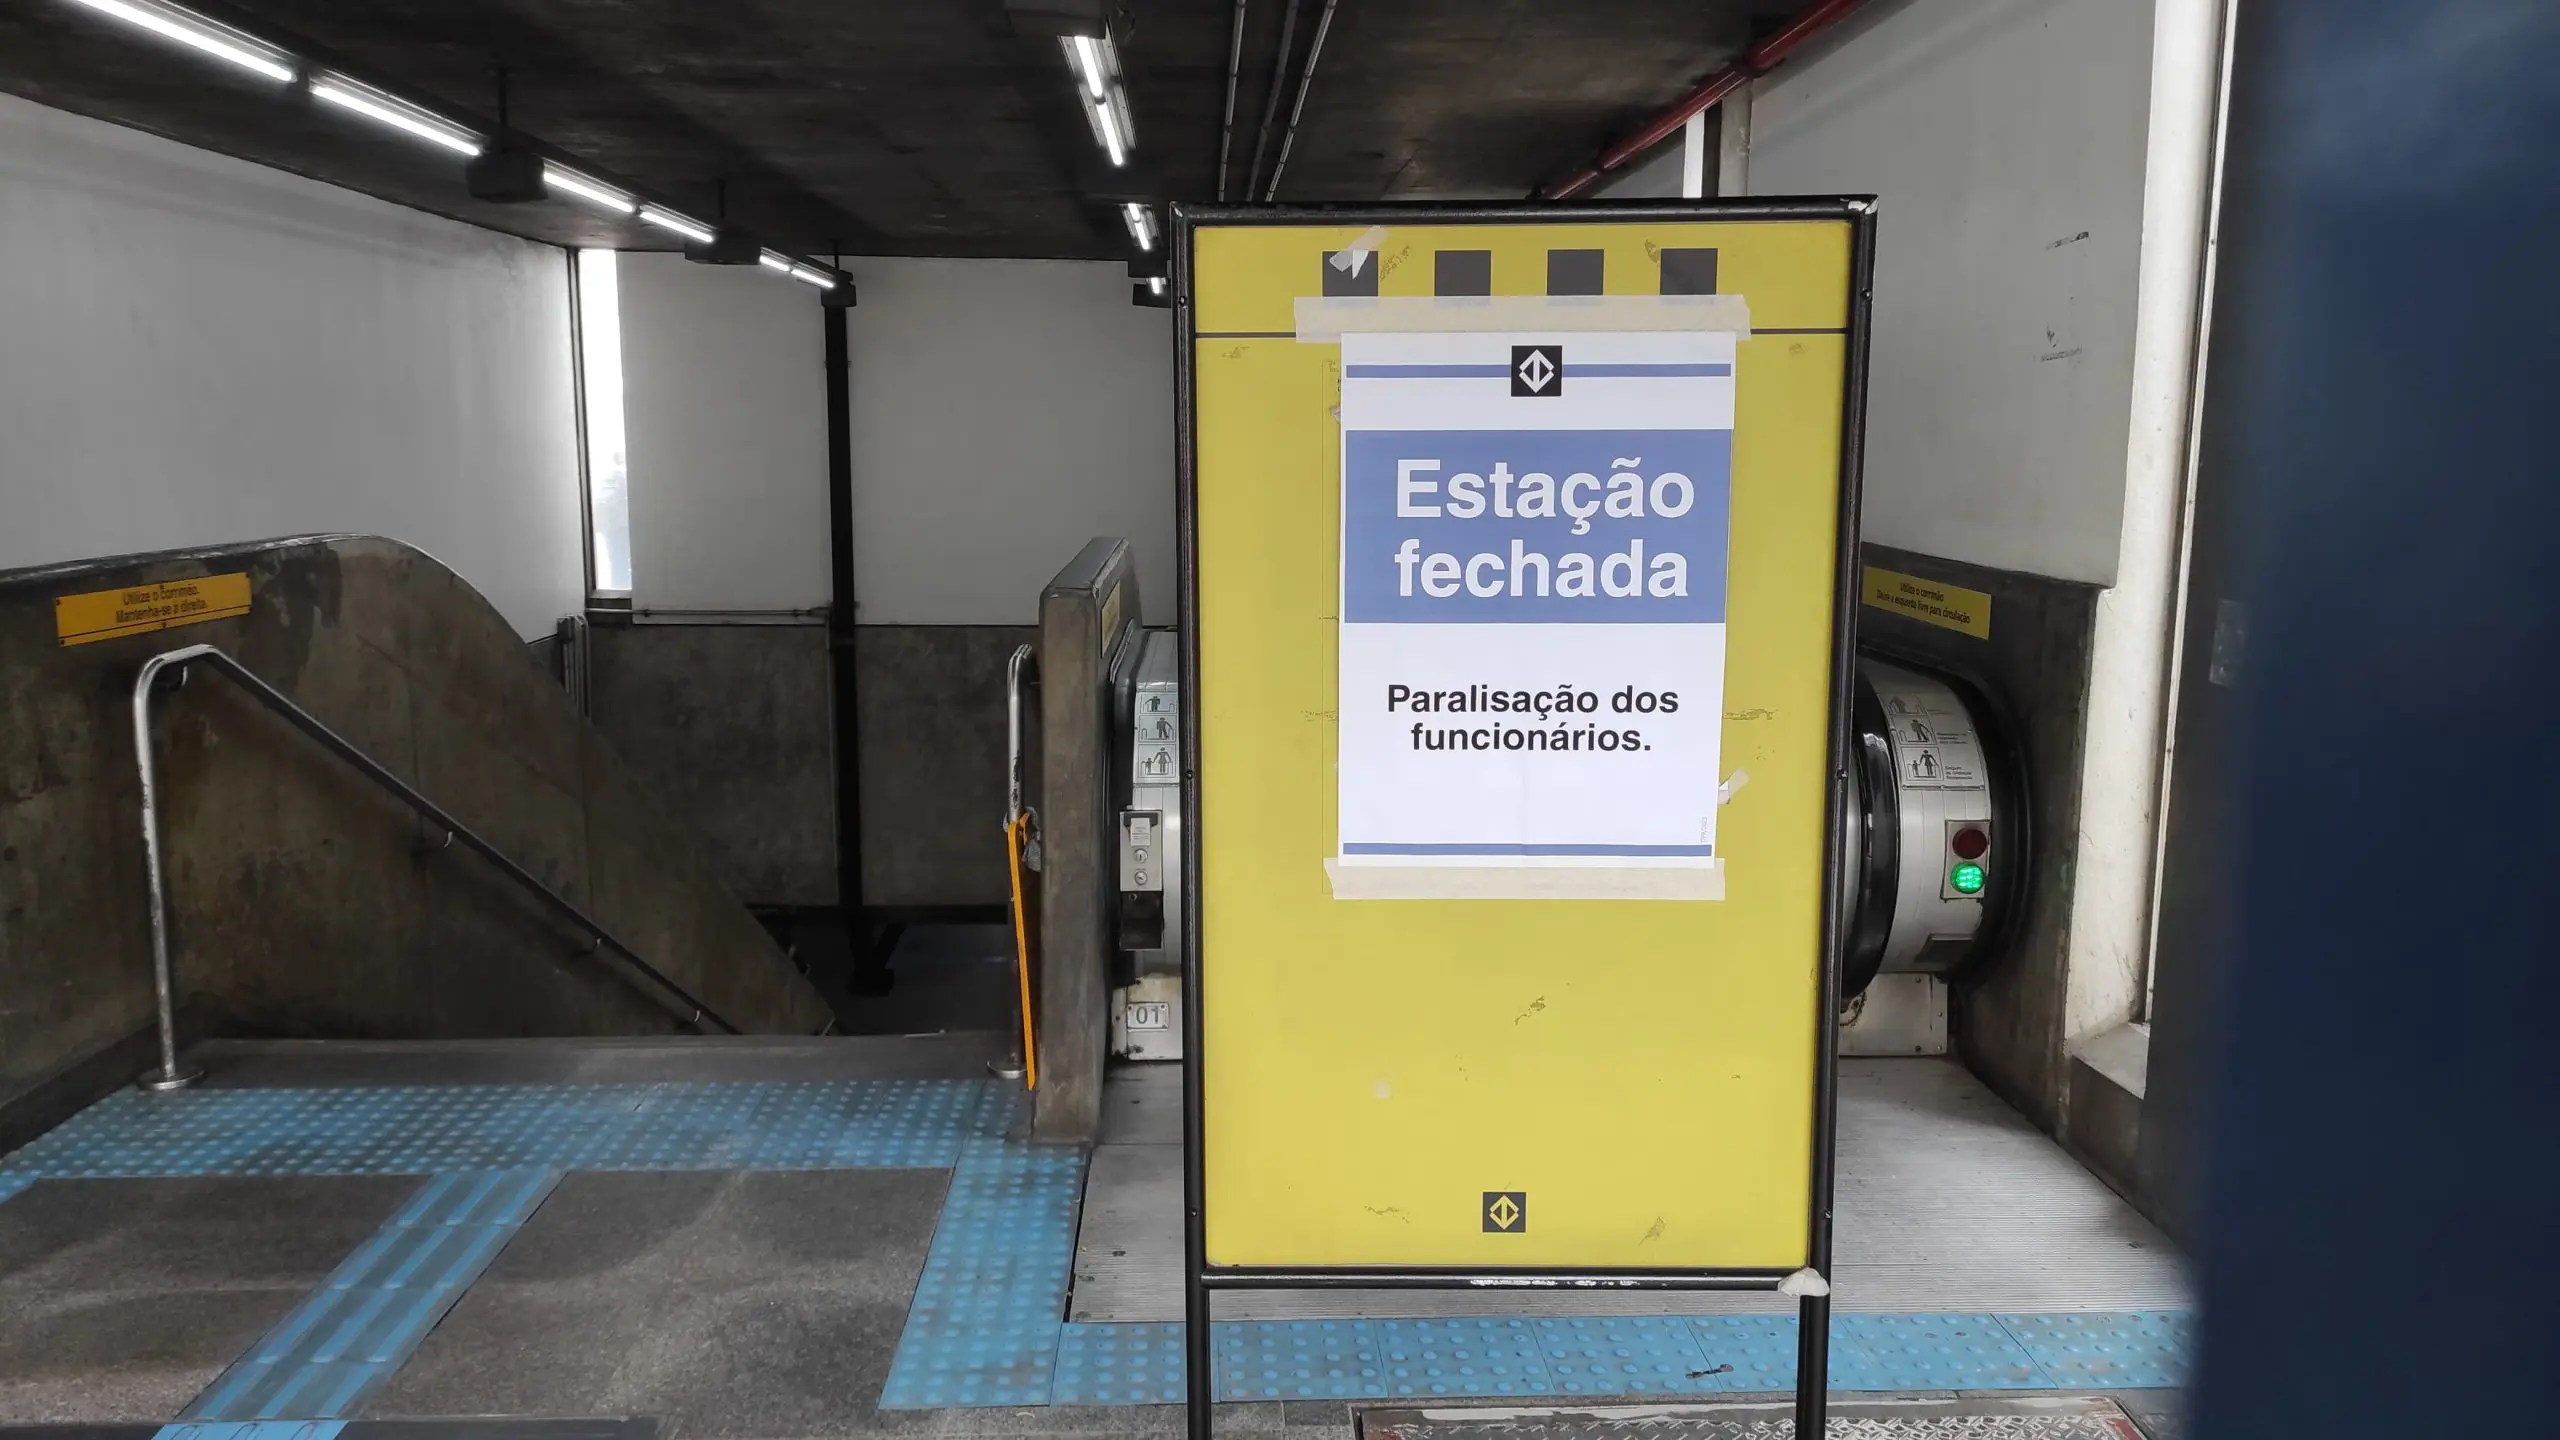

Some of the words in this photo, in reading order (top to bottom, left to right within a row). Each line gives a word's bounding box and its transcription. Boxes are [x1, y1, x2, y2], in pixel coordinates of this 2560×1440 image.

[1396, 456, 1695, 535] Estação
[1394, 539, 1689, 598] fechada
[123, 591, 151, 605] Utilize
[152, 591, 159, 602] o
[115, 605, 171, 623] Mantenha-se
[1929, 605, 1942, 617] para
[1942, 607, 1972, 624] circulação
[1387, 684, 1599, 721] Paralisação
[1611, 685, 1679, 713] dos
[1411, 722, 1651, 751] funcionários.
[1136, 1006, 1160, 1025] 01
